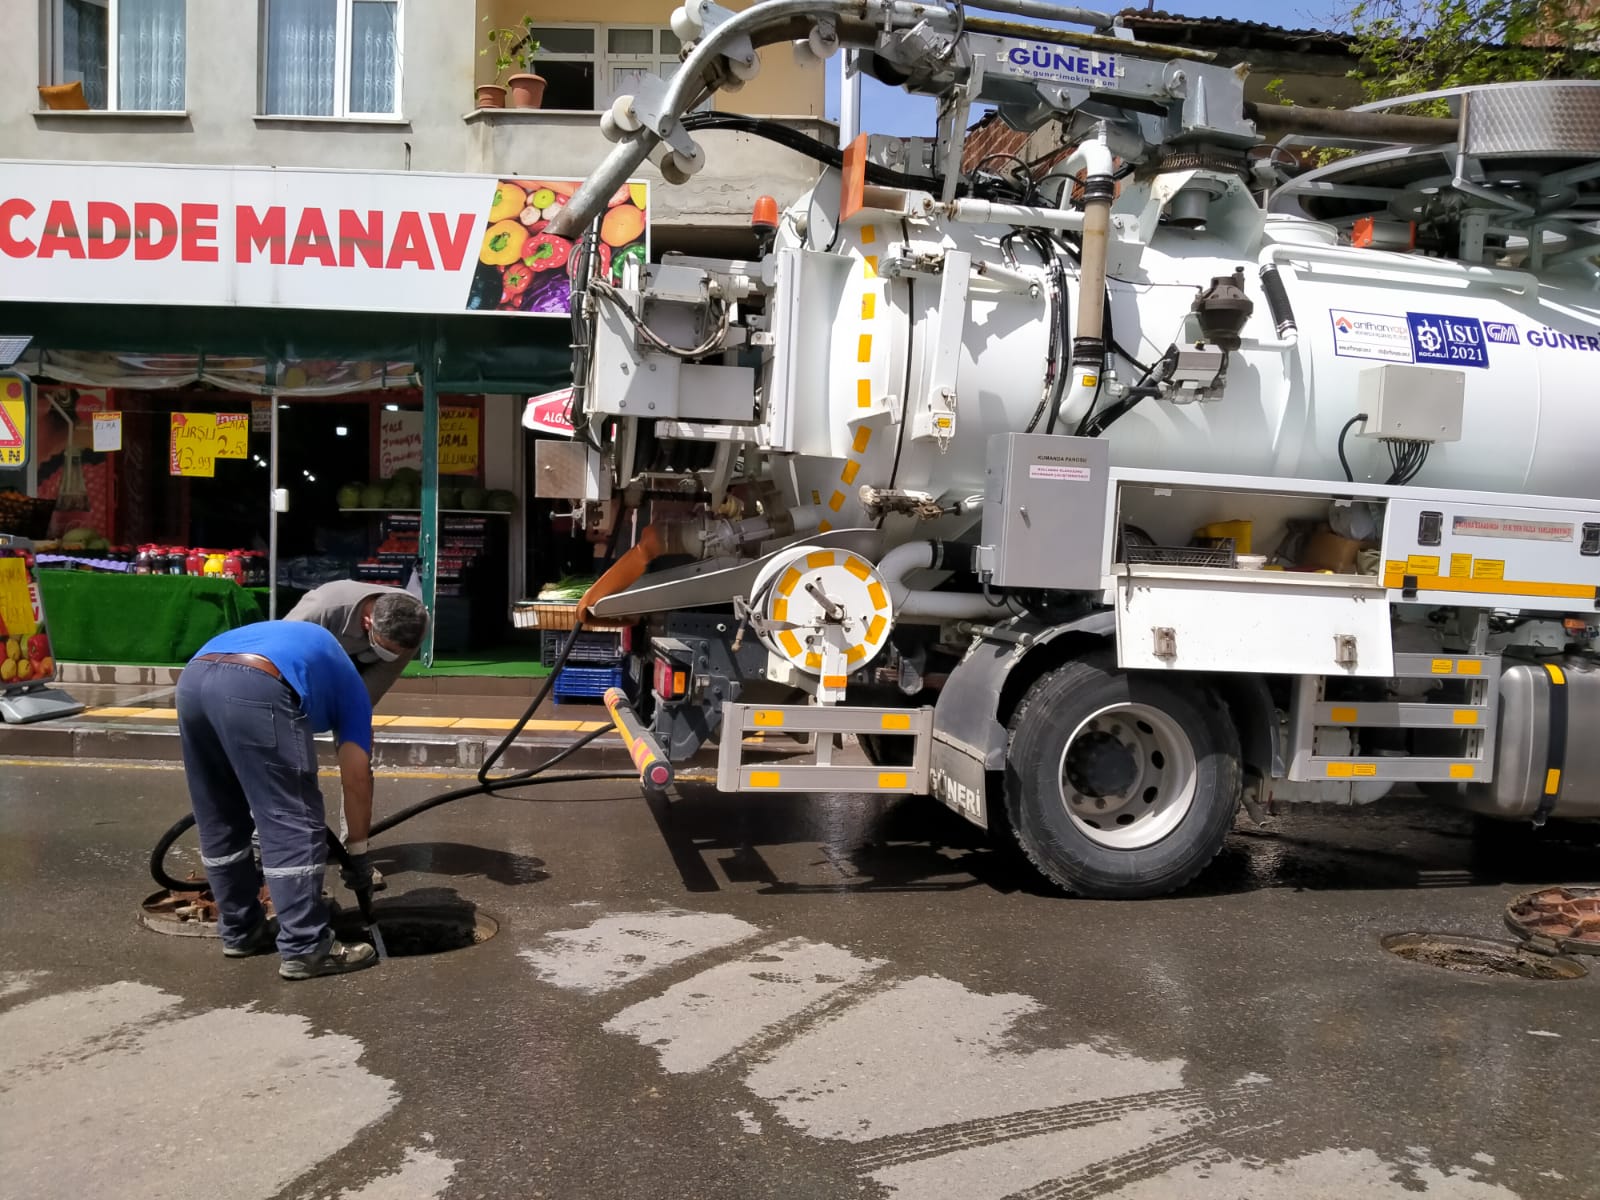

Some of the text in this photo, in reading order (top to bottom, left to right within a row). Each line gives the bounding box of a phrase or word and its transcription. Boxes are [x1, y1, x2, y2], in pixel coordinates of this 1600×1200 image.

[1008, 46, 1116, 78] GÜNERİ
[0, 198, 477, 271] CADDE MANAV
[1444, 320, 1480, 344] İSU
[1526, 326, 1600, 352] GÜNER
[1450, 345, 1484, 361] 2021
[542, 411, 574, 426] ALGI
